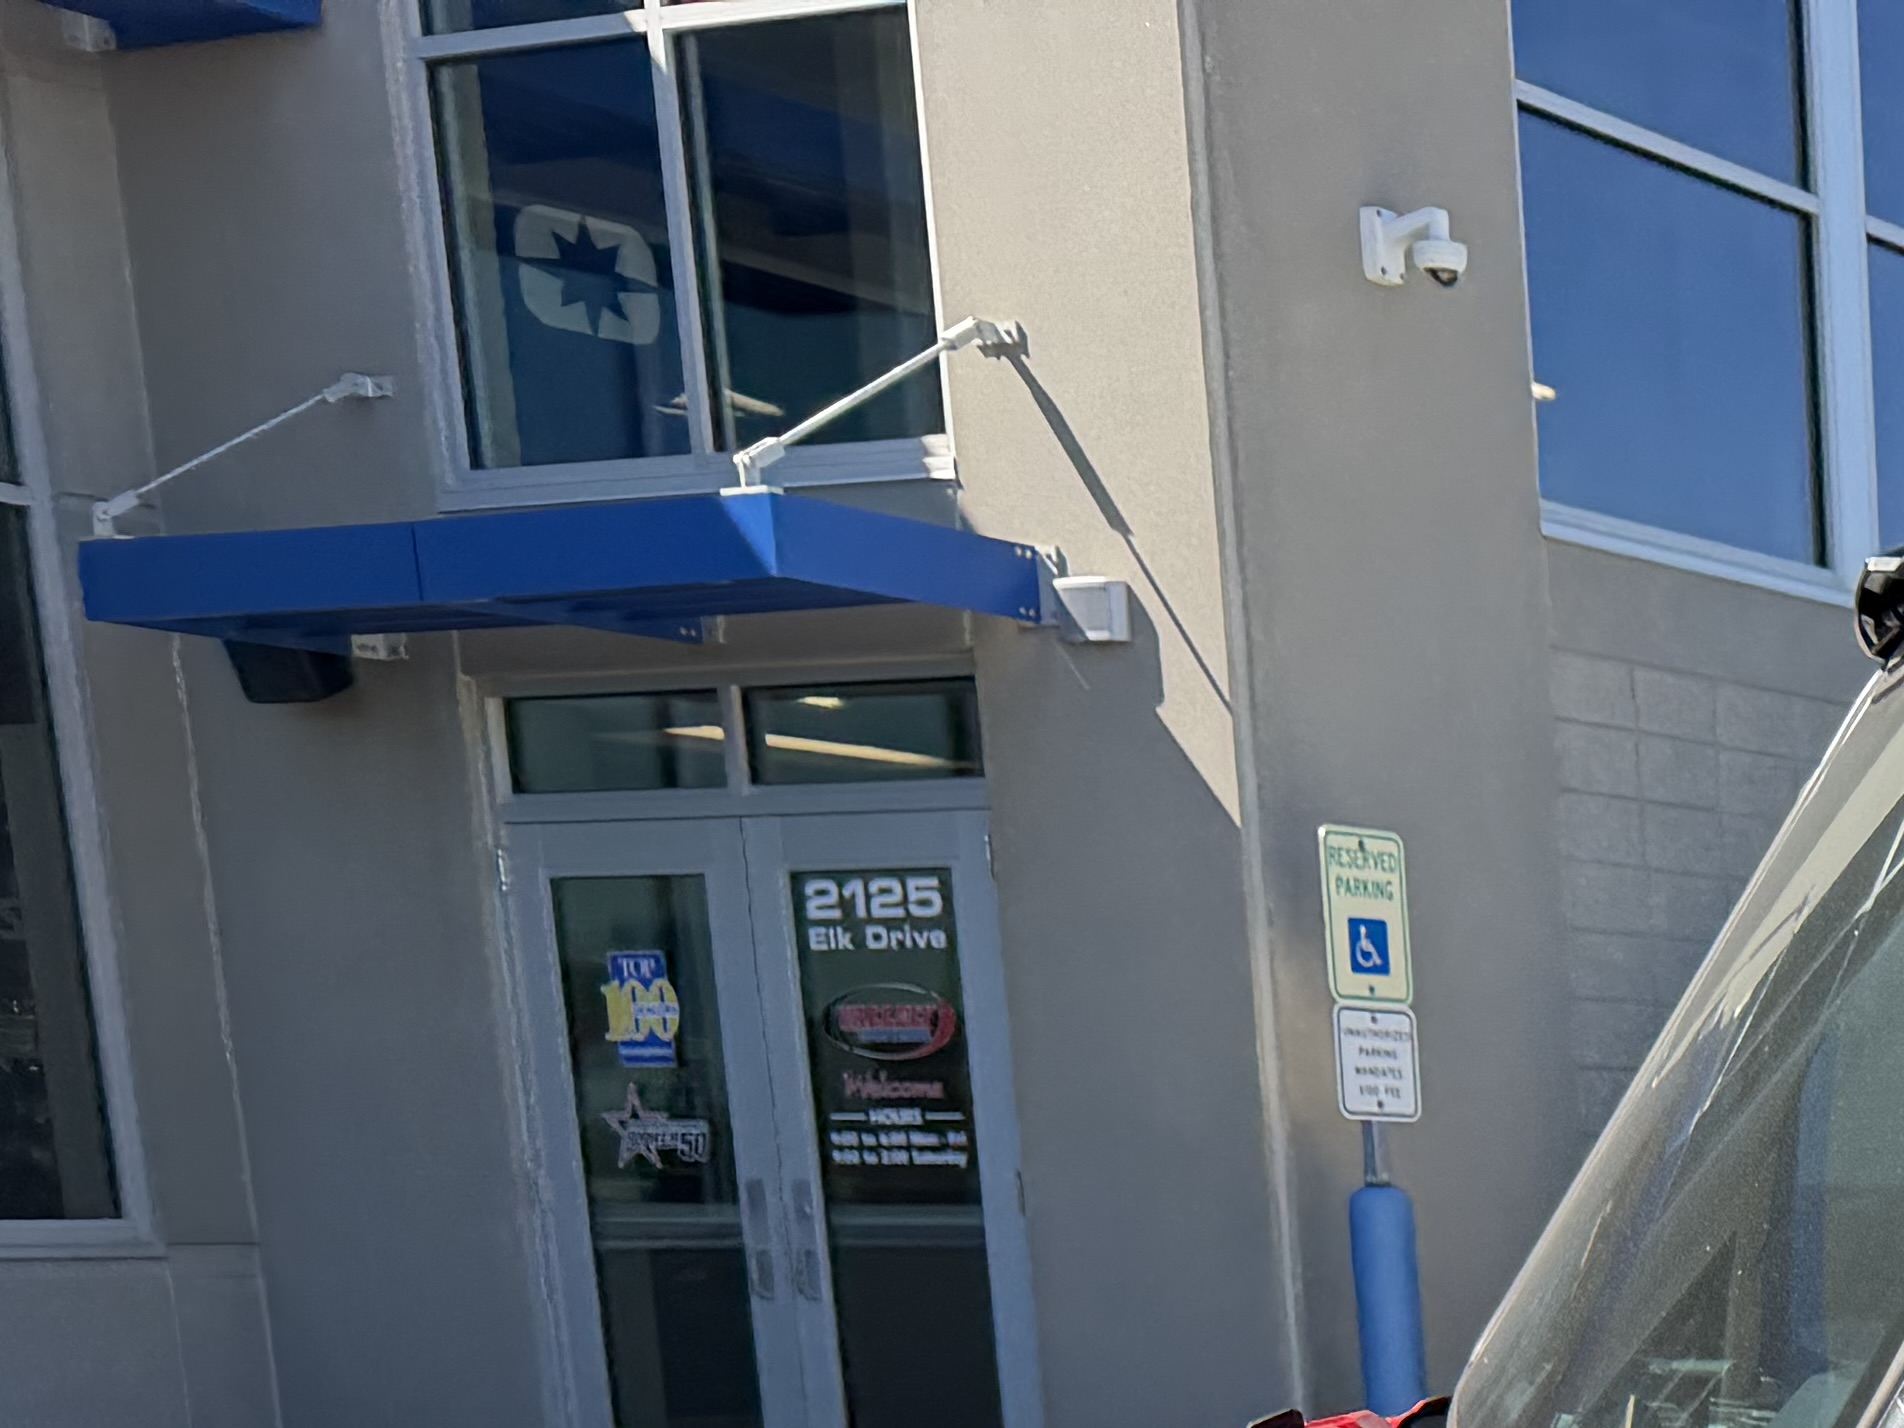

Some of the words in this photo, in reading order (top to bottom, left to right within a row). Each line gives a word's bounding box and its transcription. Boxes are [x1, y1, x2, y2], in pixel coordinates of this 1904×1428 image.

[1328, 845, 1397, 873] RESERVED
[803, 875, 944, 921] 2125
[1335, 874, 1394, 902] PARKING
[807, 925, 855, 951] Elk
[865, 923, 948, 951] Drive
[600, 977, 681, 1042] 100
[678, 1131, 709, 1162] 50
